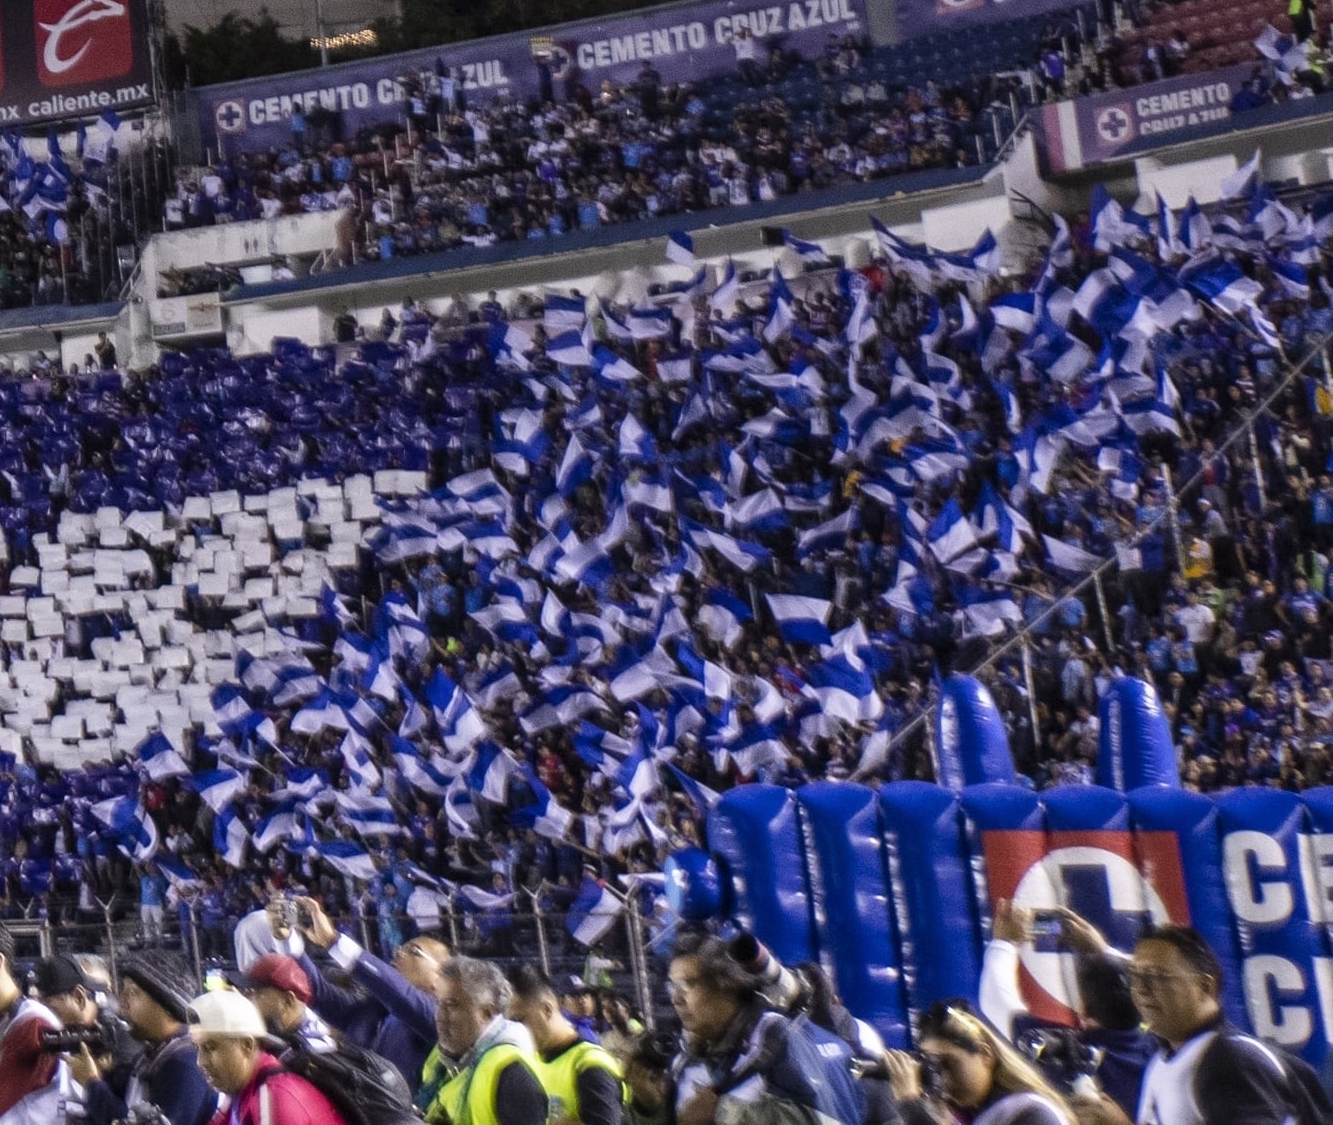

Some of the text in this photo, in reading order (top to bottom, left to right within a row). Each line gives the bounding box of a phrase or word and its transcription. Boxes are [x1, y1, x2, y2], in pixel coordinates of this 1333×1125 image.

[576, 21, 708, 70] CEMENTO
[29, 83, 148, 117] caliente.mx
[1136, 82, 1231, 117] CEMENTO
